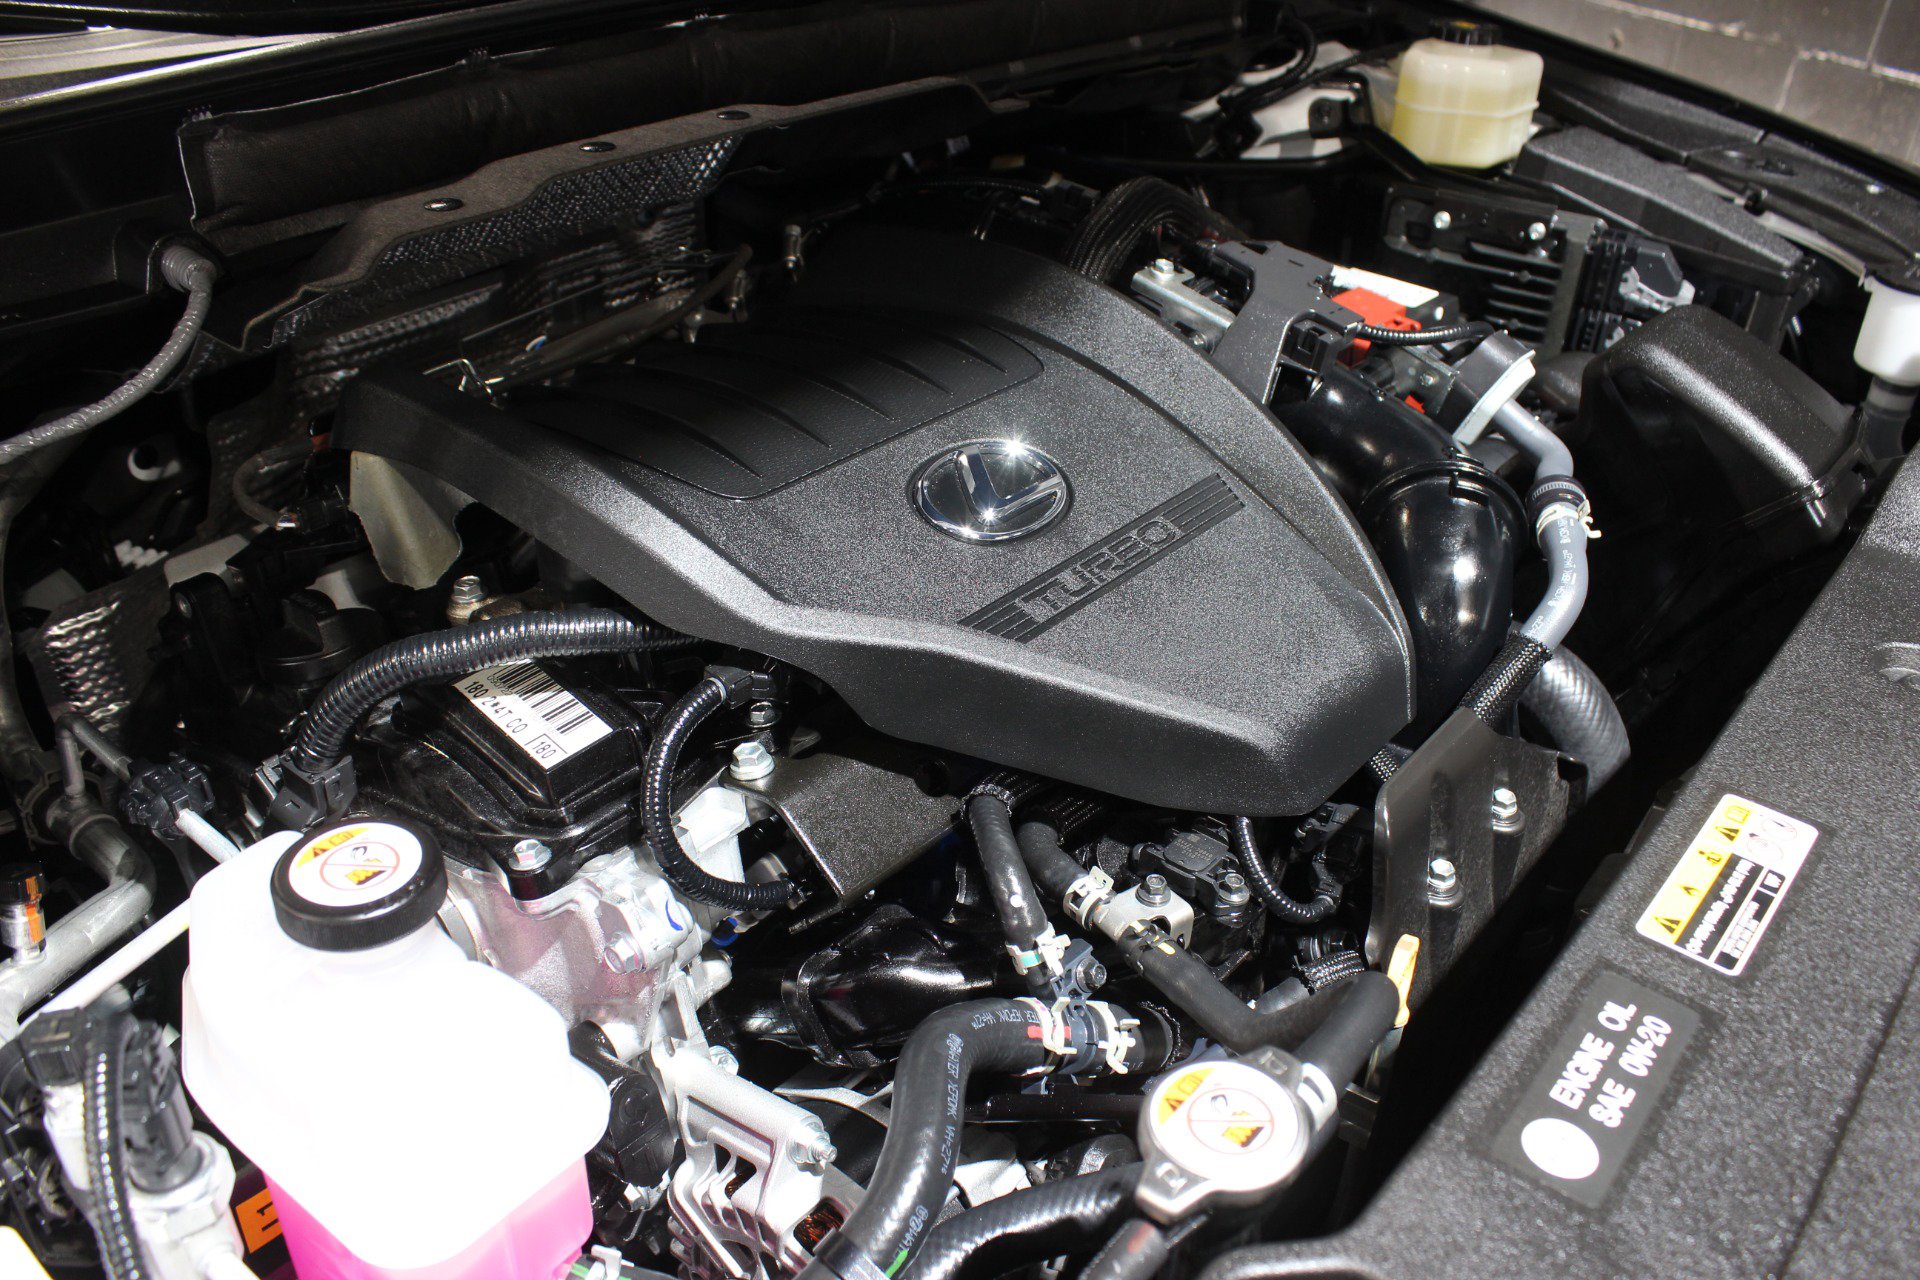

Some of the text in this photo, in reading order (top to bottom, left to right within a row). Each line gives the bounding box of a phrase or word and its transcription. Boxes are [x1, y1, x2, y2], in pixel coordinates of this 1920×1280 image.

[1018, 518, 1177, 615] TURBO
[464, 680, 489, 698] 180
[505, 717, 528, 734] CO
[532, 740, 557, 760] 180
[1549, 1001, 1637, 1110] ENGINE OIL
[1588, 1014, 1672, 1128] SAE 0W-20
